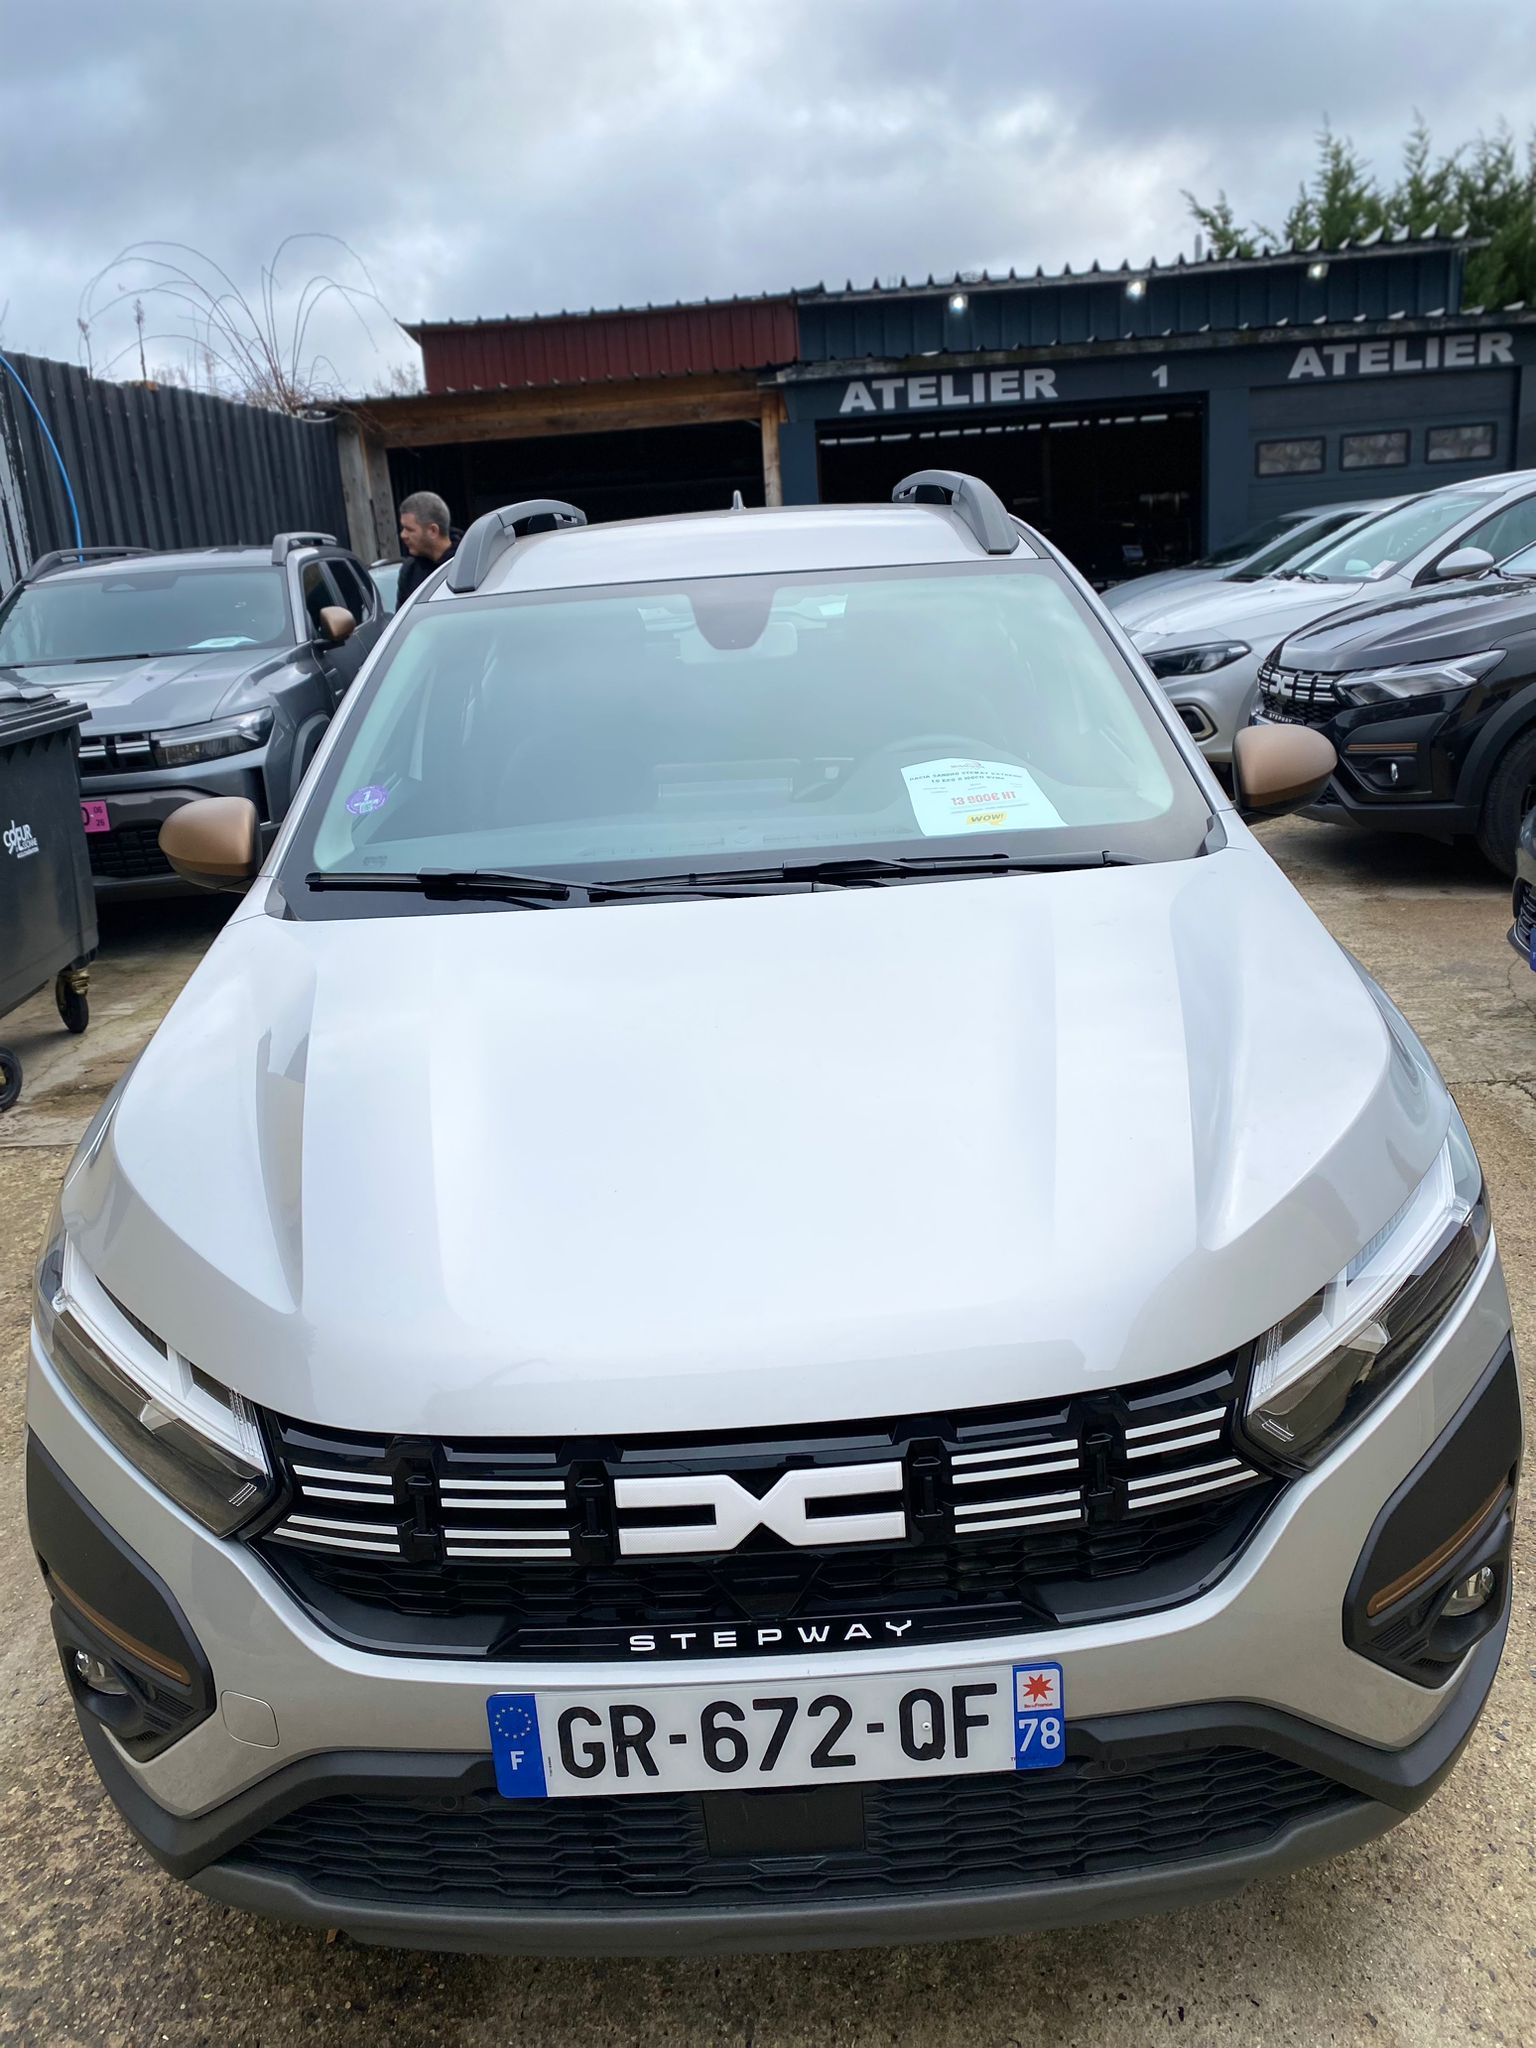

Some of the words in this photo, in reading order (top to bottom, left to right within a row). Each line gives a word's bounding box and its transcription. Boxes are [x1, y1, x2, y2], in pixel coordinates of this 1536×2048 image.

[1288, 332, 1515, 379] ATELIER
[839, 367, 1058, 413] ATELIER
[1152, 364, 1168, 388] 1
[970, 813, 1004, 822] WOW!
[629, 1619, 913, 1652] STEPWAY
[510, 1750, 525, 1771] F
[557, 1683, 998, 1779] GR-672-QF
[1018, 1716, 1061, 1752] 78
